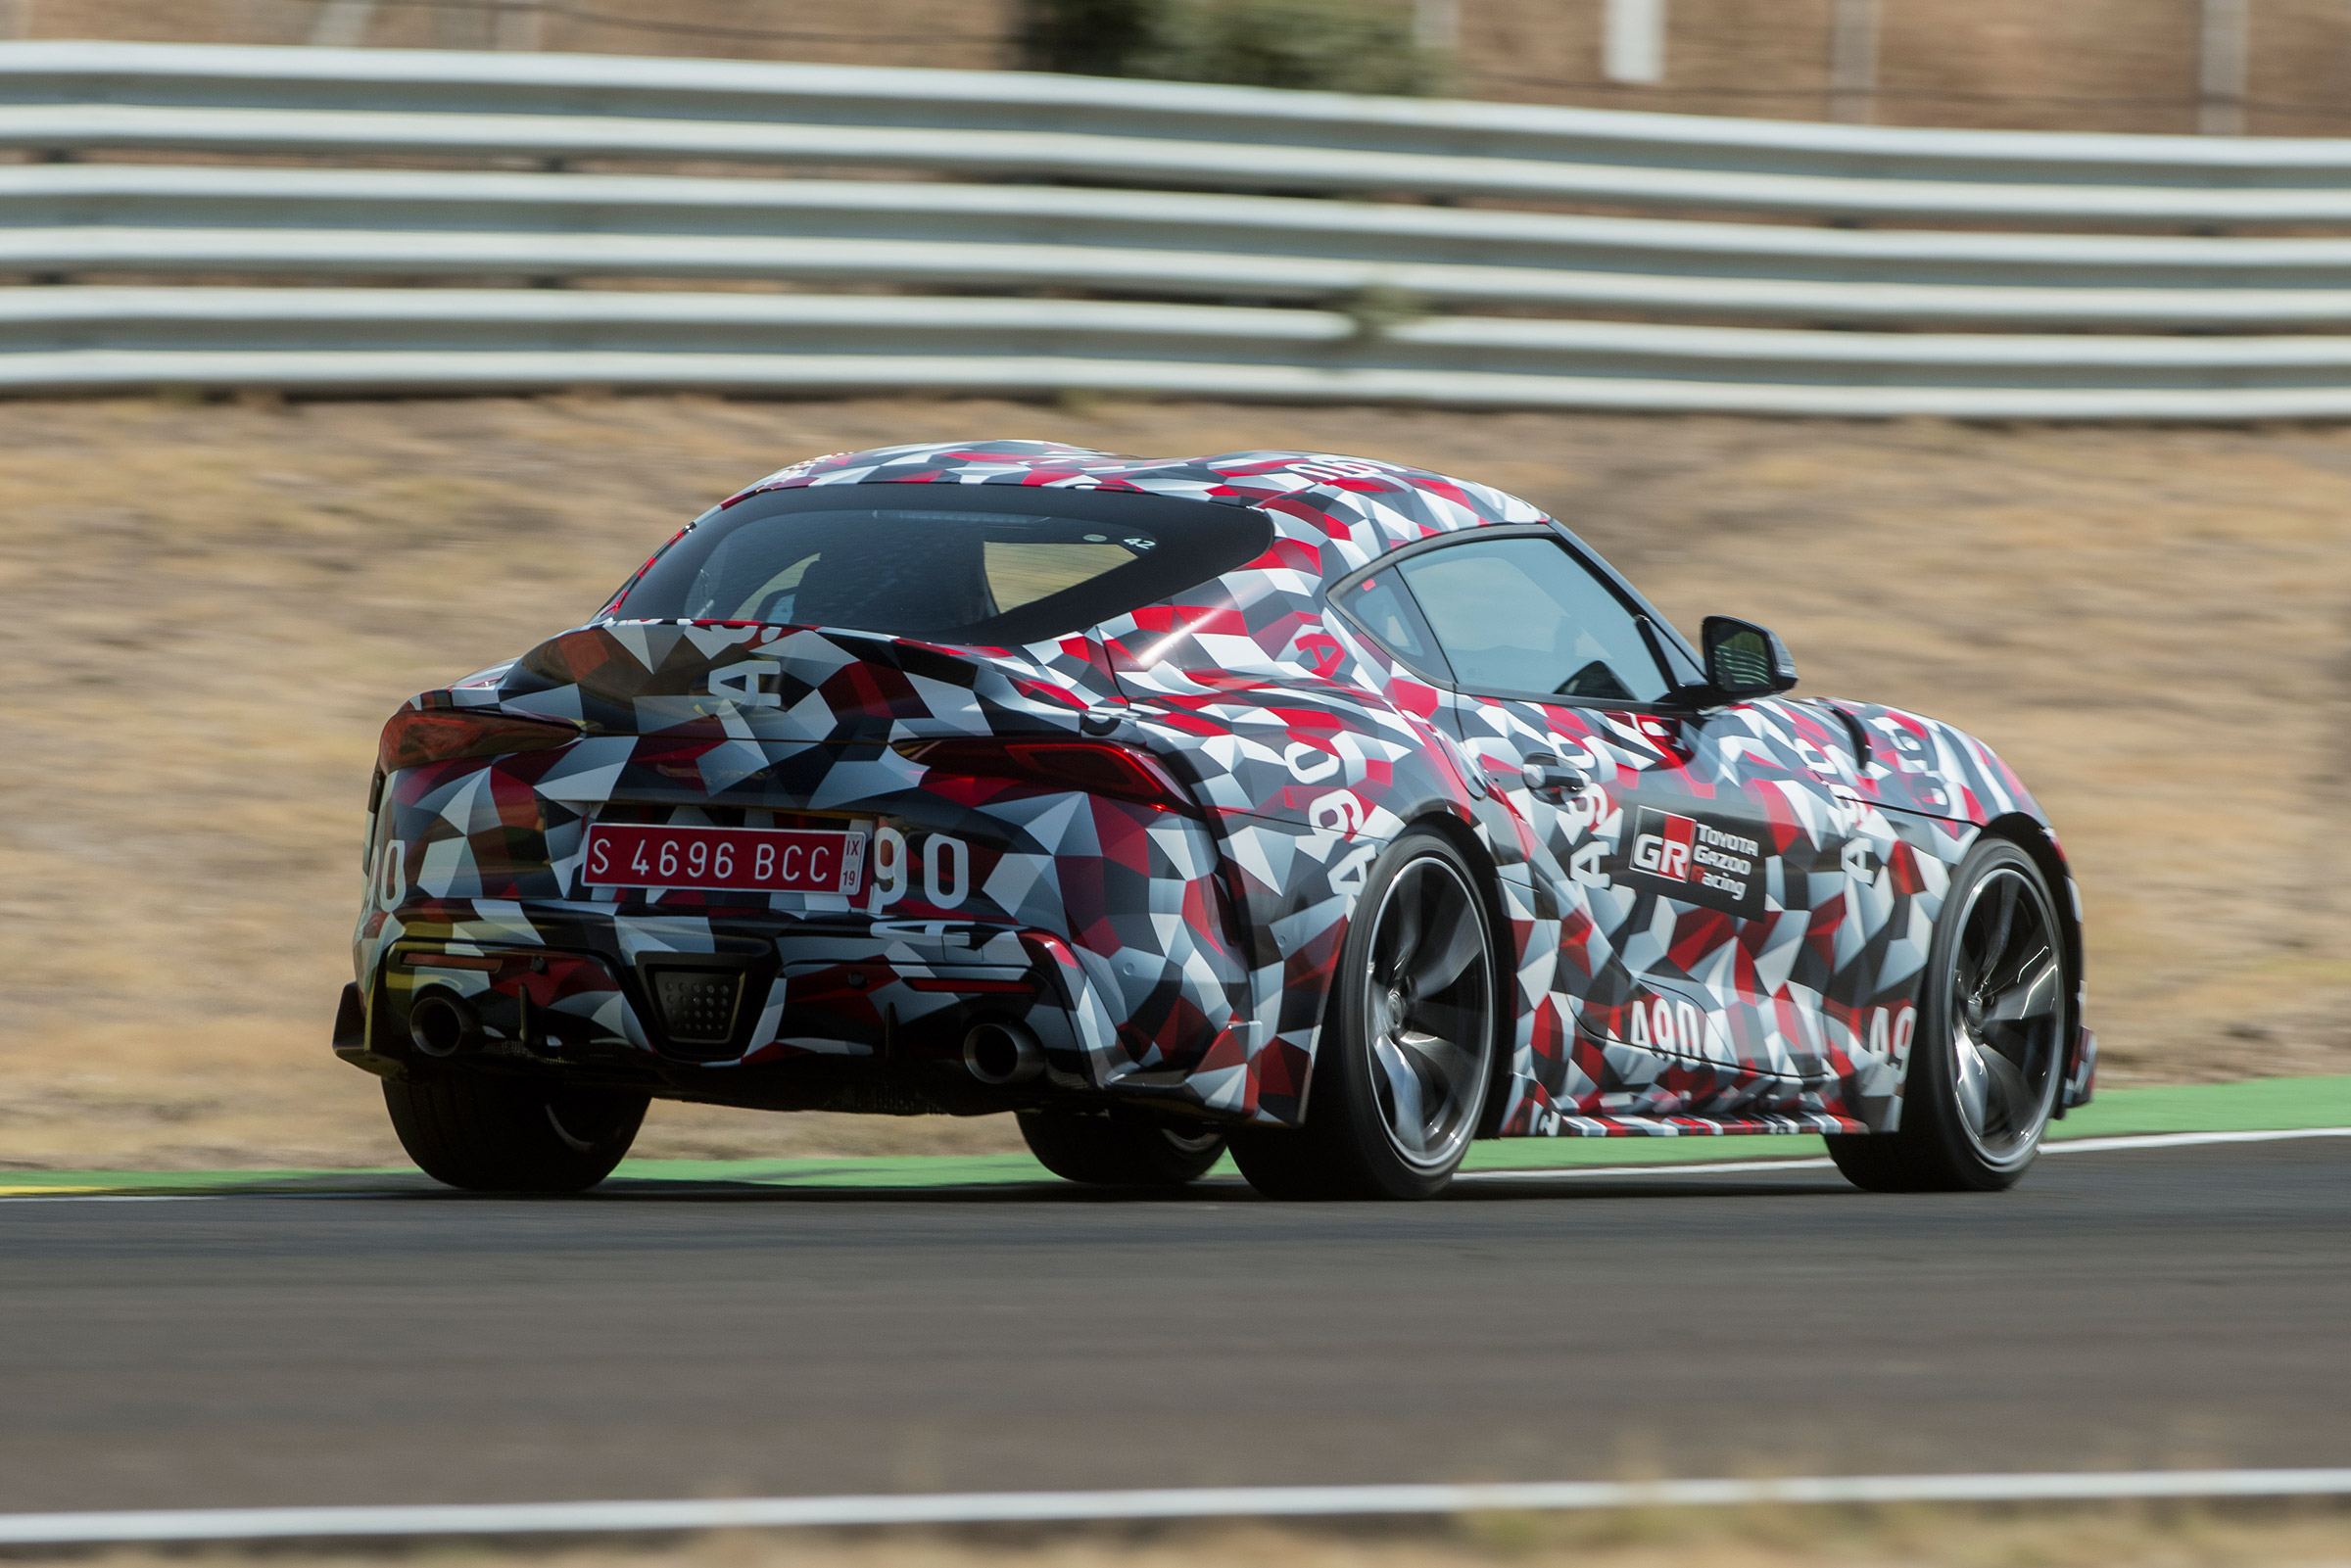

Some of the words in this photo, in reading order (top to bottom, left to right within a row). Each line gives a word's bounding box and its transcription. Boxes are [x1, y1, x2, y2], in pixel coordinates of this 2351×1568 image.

[1123, 538, 1156, 549] 42
[1294, 633, 1346, 678] A
[1284, 740, 1376, 897] A90
[591, 838, 611, 875] S
[631, 839, 735, 879] 4696
[754, 843, 830, 882] BCC
[846, 839, 860, 856] IX
[1633, 832, 1692, 879] GR
[842, 870, 857, 886] 19
[1690, 864, 1747, 901] Racing
